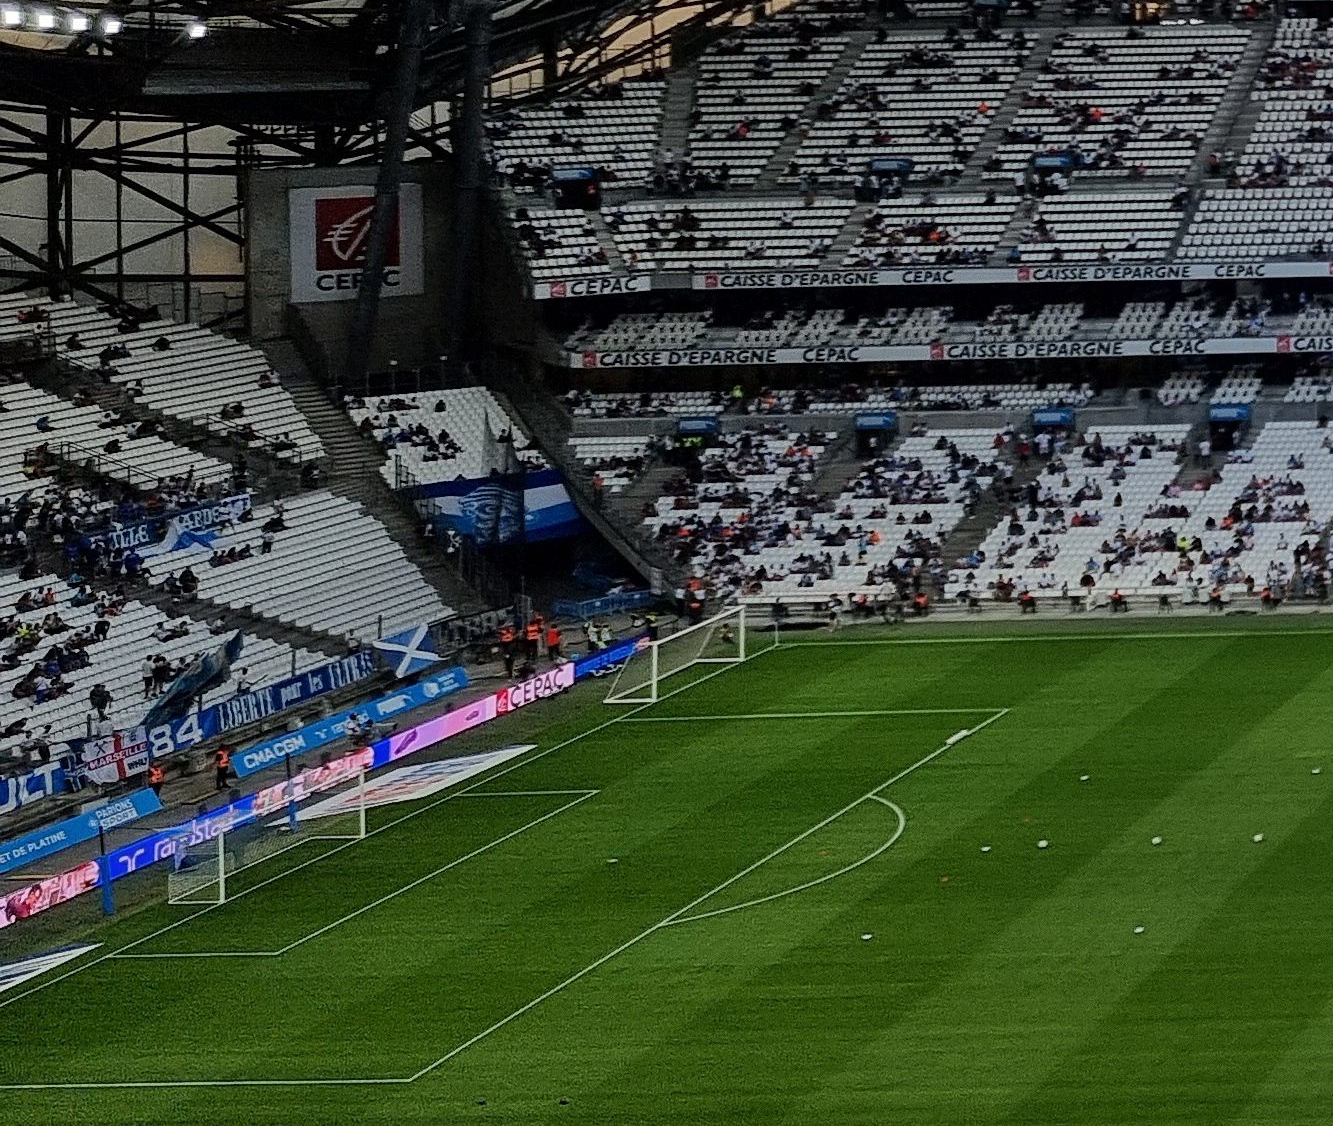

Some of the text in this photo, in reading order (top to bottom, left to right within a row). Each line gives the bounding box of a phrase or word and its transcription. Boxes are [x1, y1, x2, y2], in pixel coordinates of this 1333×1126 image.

[316, 270, 400, 291] CEPC
[720, 271, 954, 287] CAISSE D'EPARGNE CEPAC
[1033, 265, 1265, 281] CAISSE D'EPARGNE CEPAC
[570, 278, 637, 295] CEPAC
[602, 348, 859, 367] CAISSE D'EPARGNE CEPAC
[950, 340, 1205, 358] CAISSE D'EPARGNE CEPAC
[308, 672, 324, 693] les
[510, 669, 565, 709] CEPAC
[149, 713, 204, 757] 84
[88, 742, 148, 770] MARSEILLE
[95, 798, 134, 819] PARIONS
[101, 809, 138, 828] SPORT
[13, 846, 28, 858] DE
[27, 830, 67, 852] PLATINE
